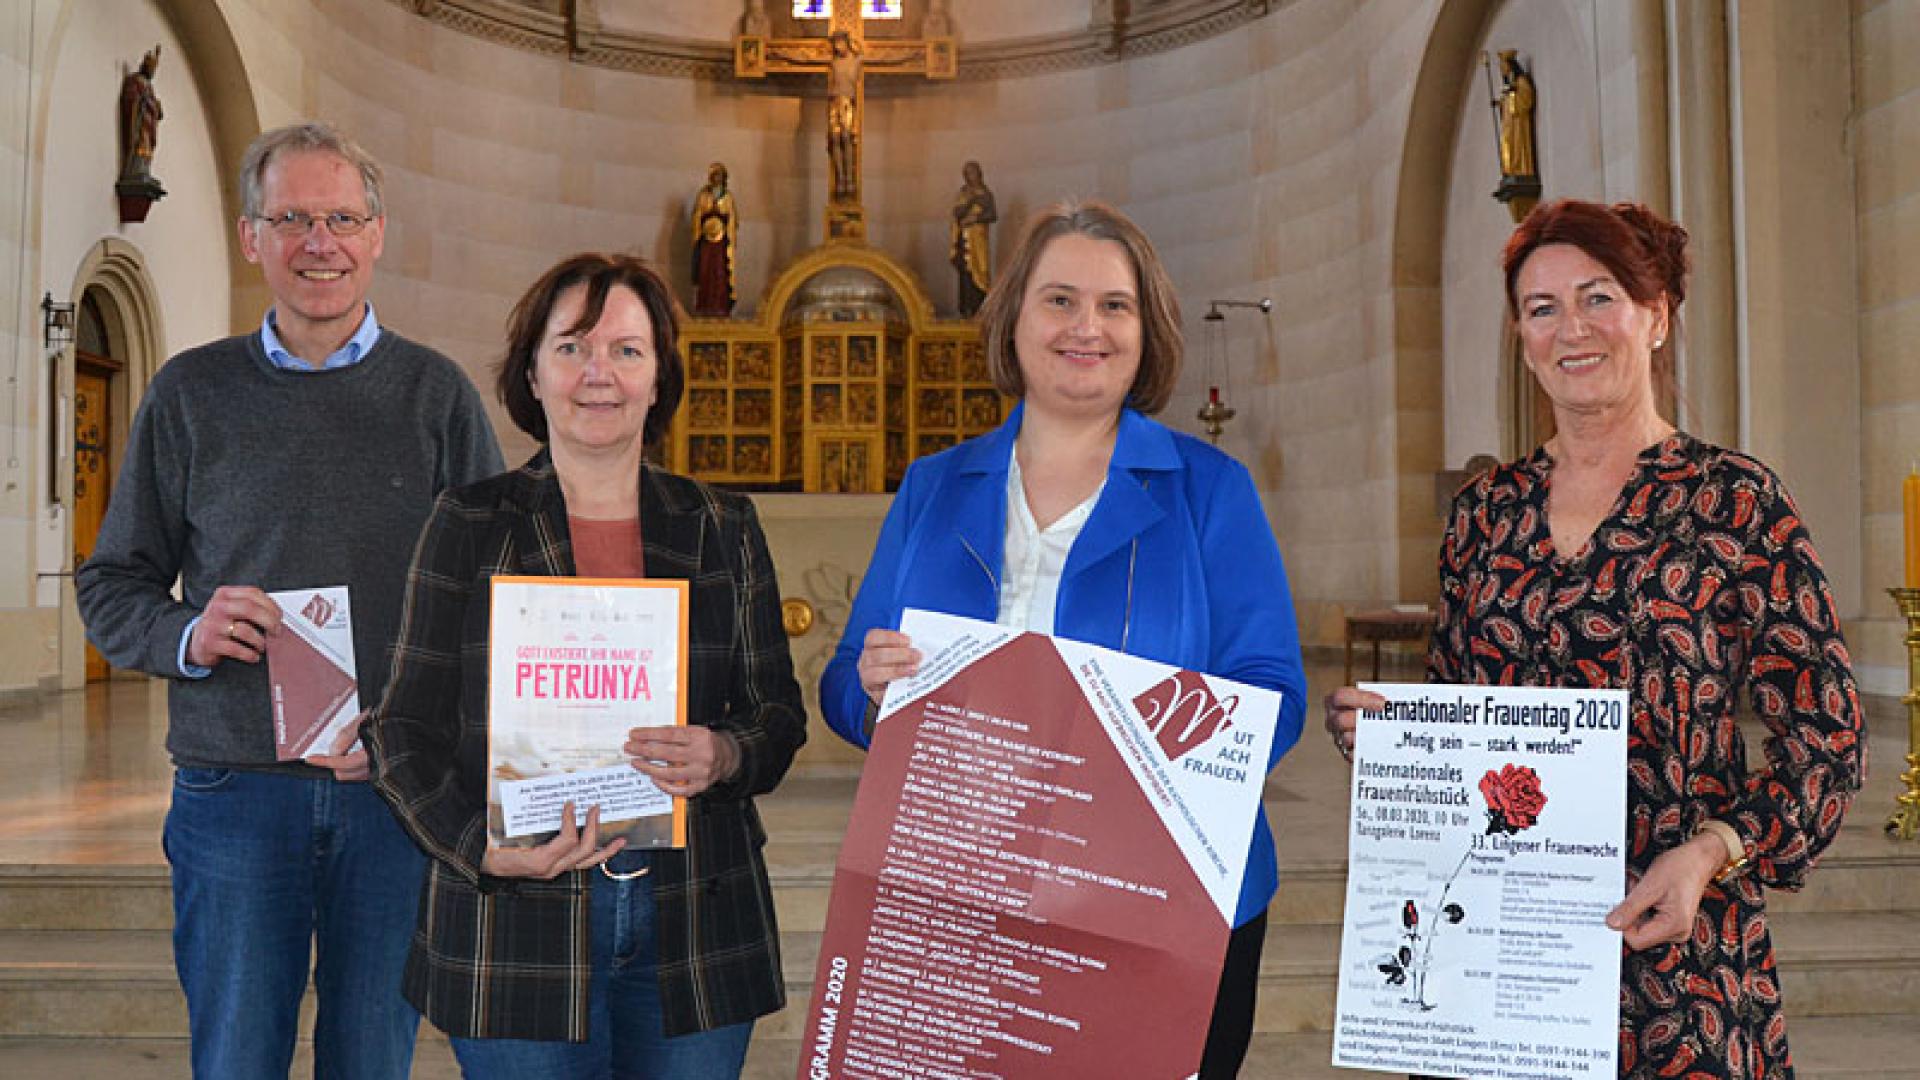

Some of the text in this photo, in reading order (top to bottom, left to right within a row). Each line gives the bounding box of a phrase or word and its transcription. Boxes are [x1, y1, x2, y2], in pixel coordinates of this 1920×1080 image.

[516, 662, 652, 700] PETRUNYA
[1484, 696, 1570, 734] Frauentag
[1575, 699, 1621, 731] 2020
[1235, 732, 1254, 746] UT
[1439, 733, 1464, 750] sein
[1487, 735, 1519, 752] stark
[1218, 747, 1250, 764] ACH
[1184, 759, 1246, 783] FRAUEN
[1357, 758, 1463, 783] Internationales
[1357, 780, 1470, 807] Frauenfrühstück
[1451, 811, 1470, 826] Uhr
[1409, 824, 1441, 841] Lorenz
[1470, 834, 1619, 858] 33. Lingener Frauenwoche
[824, 956, 848, 1004] 2020
